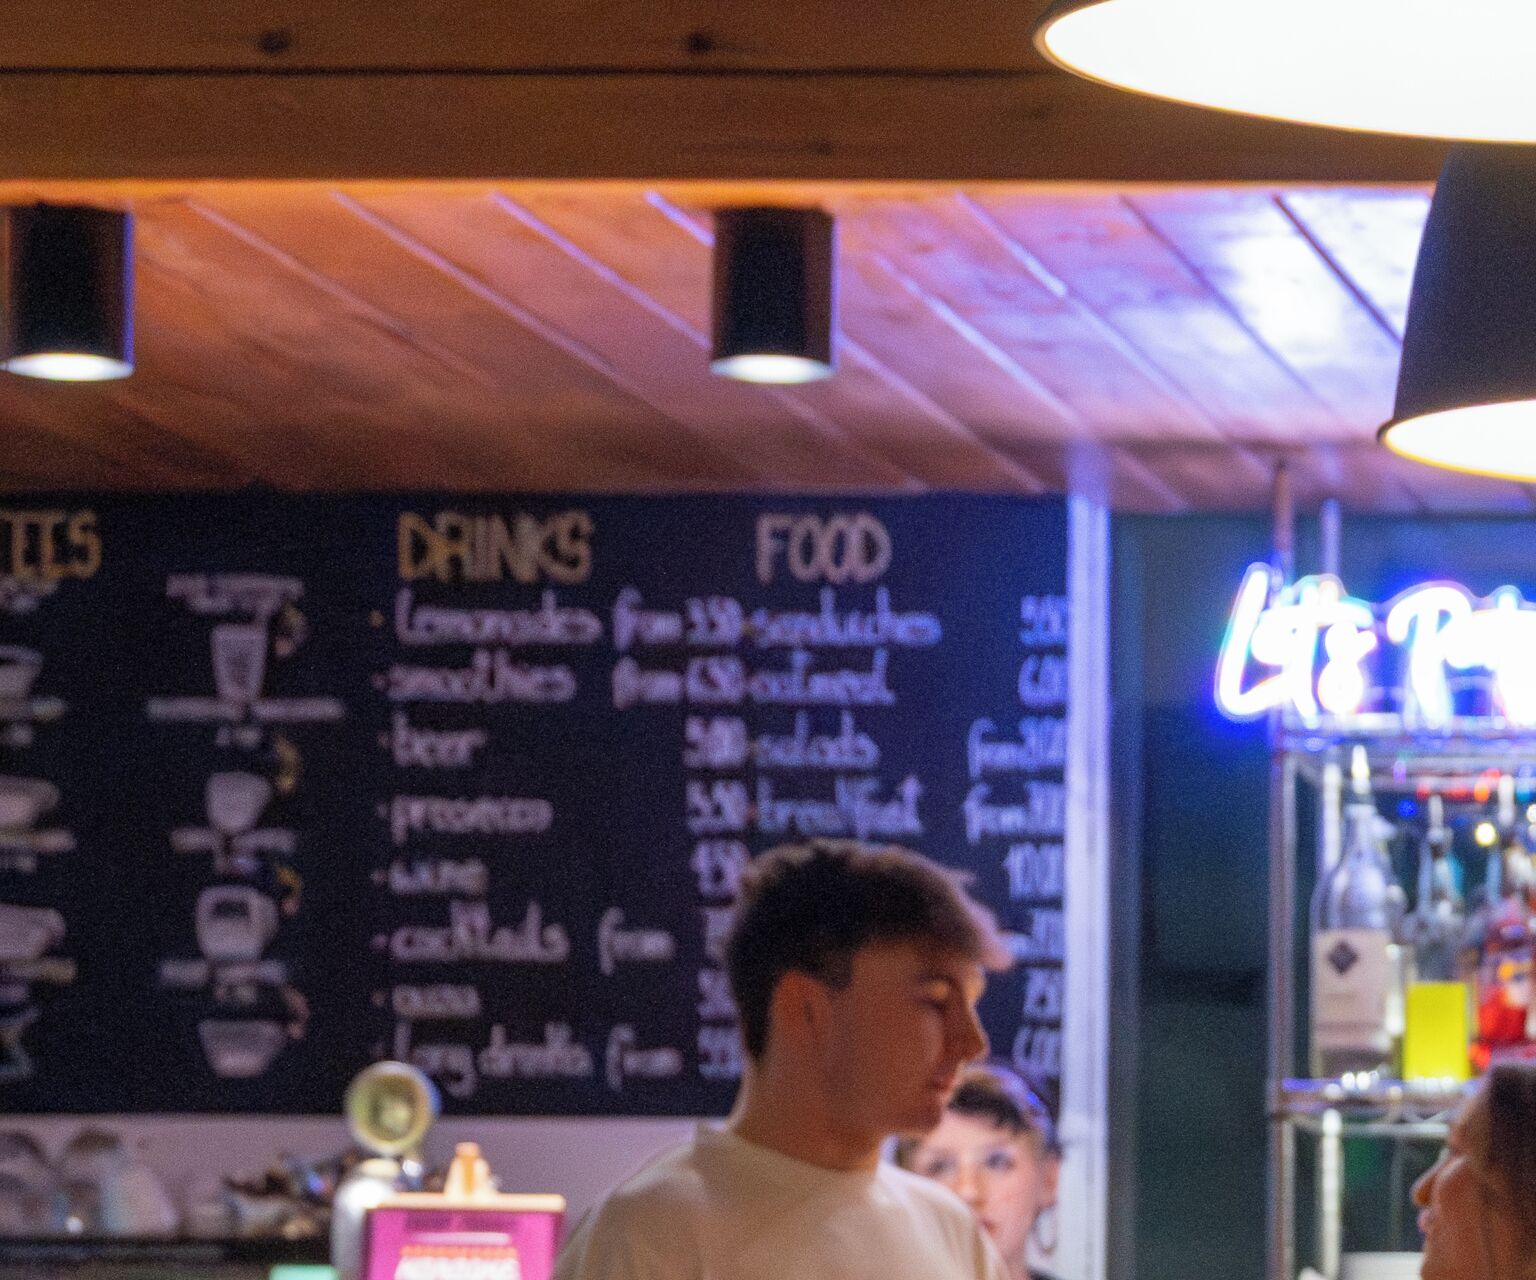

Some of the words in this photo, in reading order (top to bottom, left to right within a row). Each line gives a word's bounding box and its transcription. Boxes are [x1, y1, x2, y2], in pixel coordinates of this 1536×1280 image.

[397, 510, 595, 584] DRINKS
[756, 511, 892, 585] FOOD
[391, 711, 489, 768] beer
